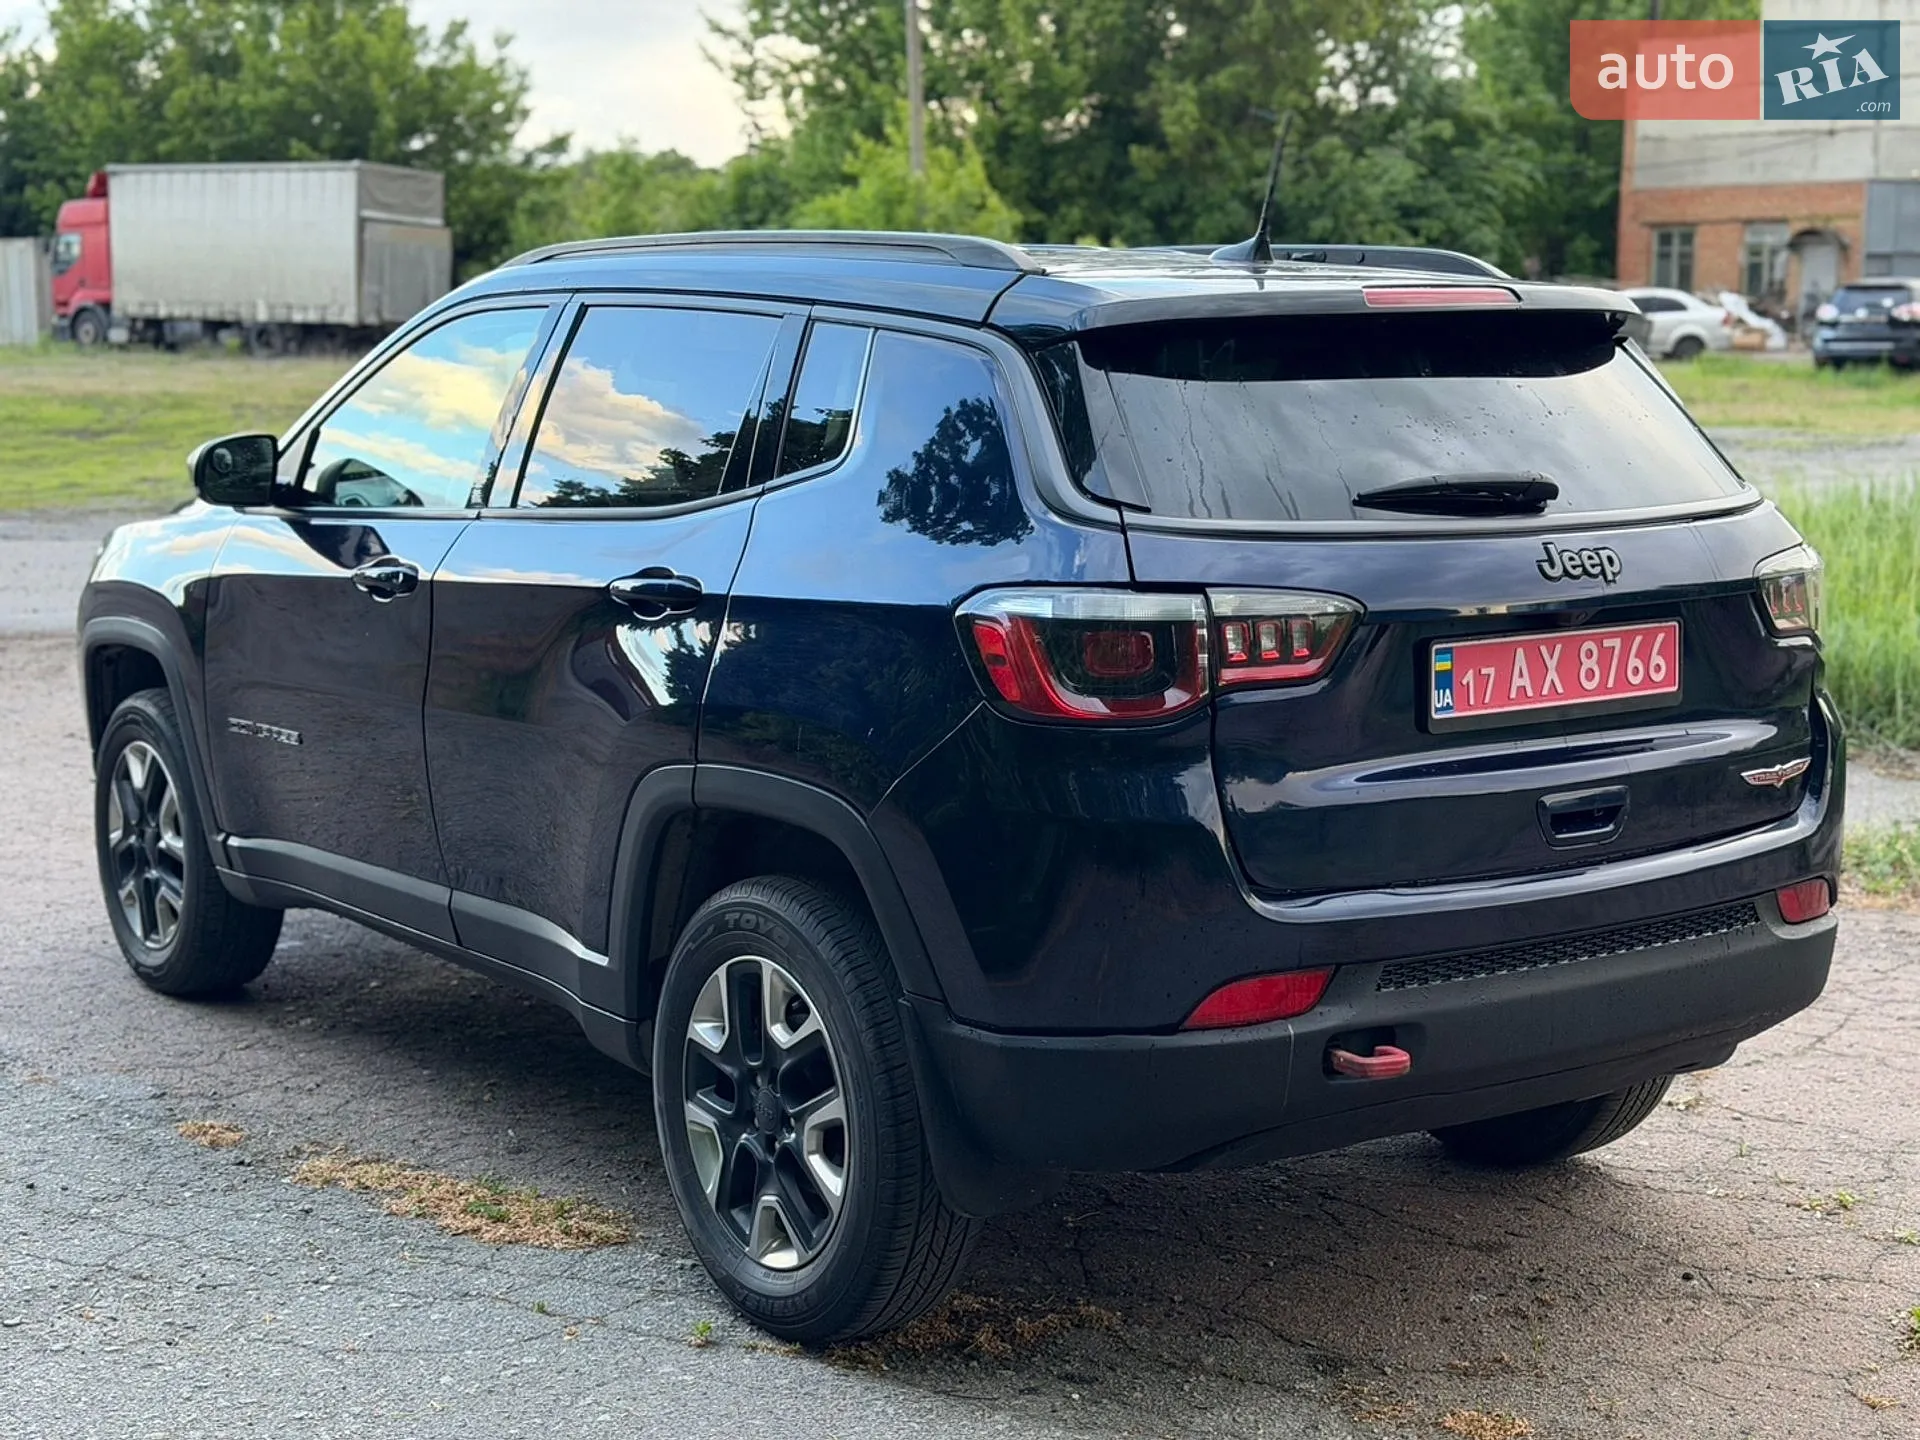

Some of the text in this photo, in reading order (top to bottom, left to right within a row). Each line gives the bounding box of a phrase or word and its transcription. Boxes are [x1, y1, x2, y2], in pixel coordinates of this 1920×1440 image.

[1536, 542, 1622, 585] Jeep
[1461, 632, 1667, 706] 17 AX 8766
[1434, 688, 1454, 708] UA
[724, 911, 791, 949] TOYO
